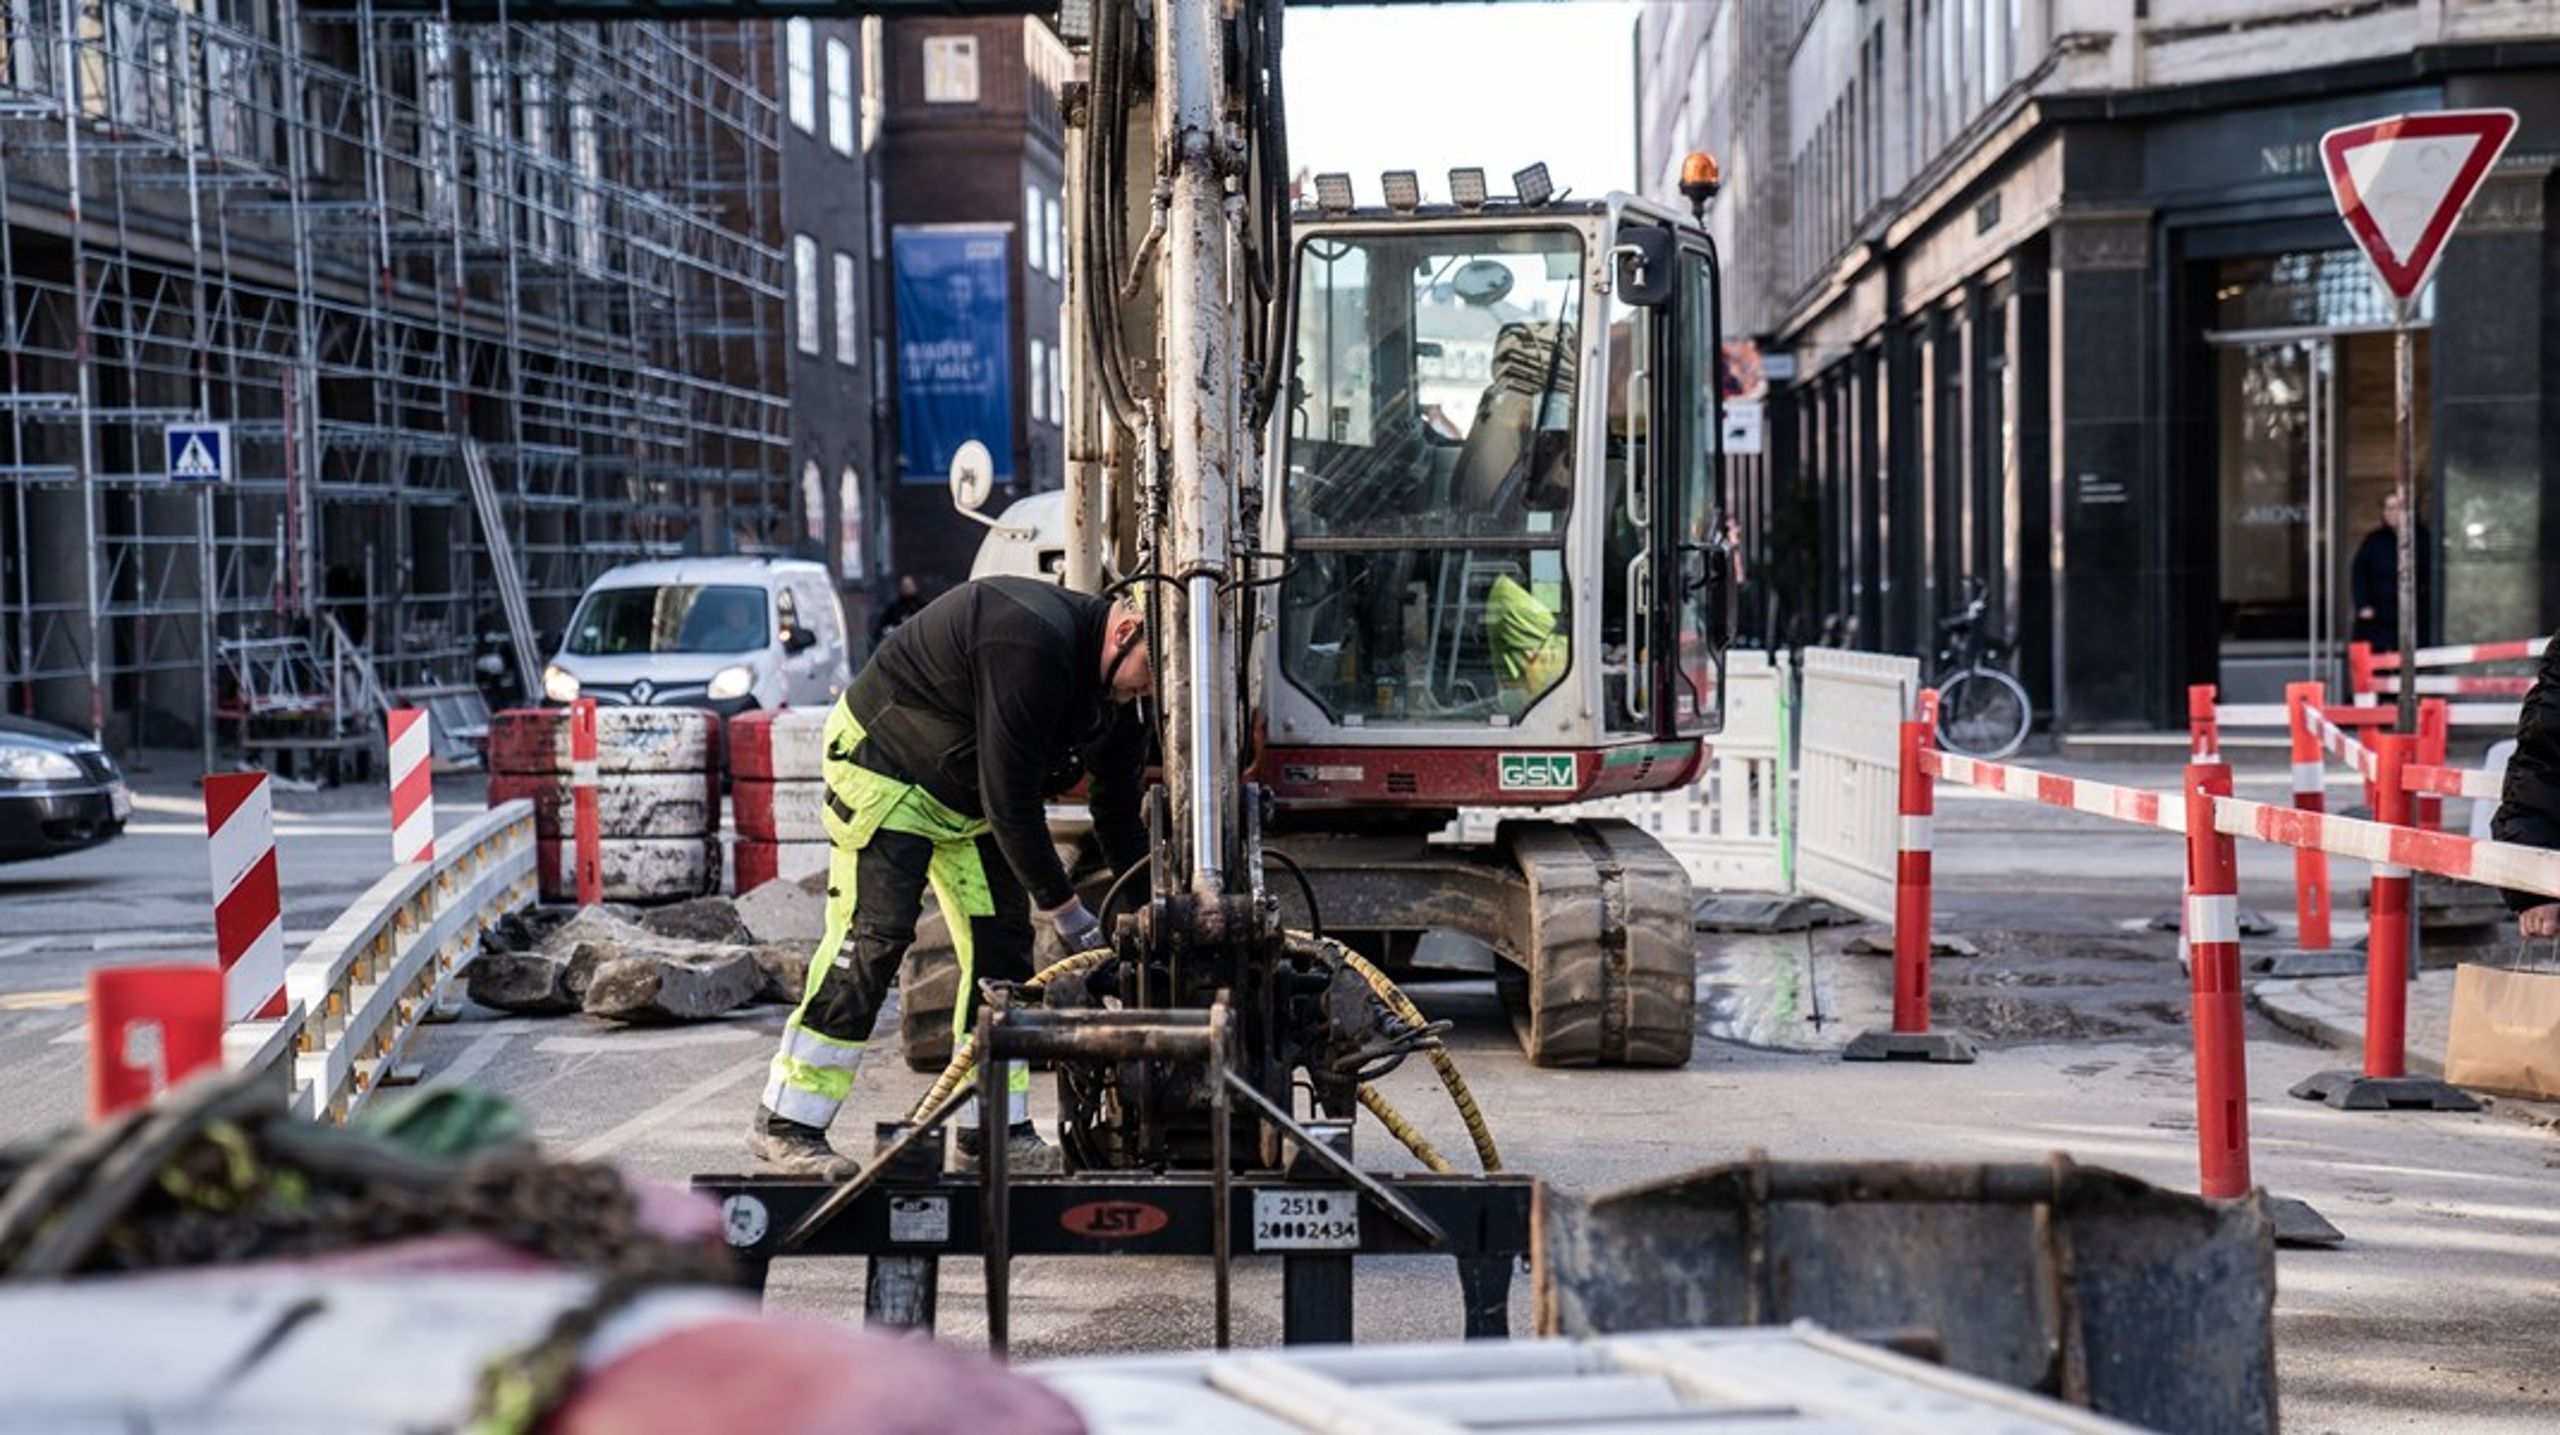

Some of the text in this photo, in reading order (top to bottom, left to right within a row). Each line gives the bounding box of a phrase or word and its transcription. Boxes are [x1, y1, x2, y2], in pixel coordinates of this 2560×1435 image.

[1504, 765, 1571, 785] GSV
[1280, 1198, 1329, 1215] 2510
[1087, 1207, 1142, 1232] JST
[1259, 1221, 1356, 1239] 20002434
